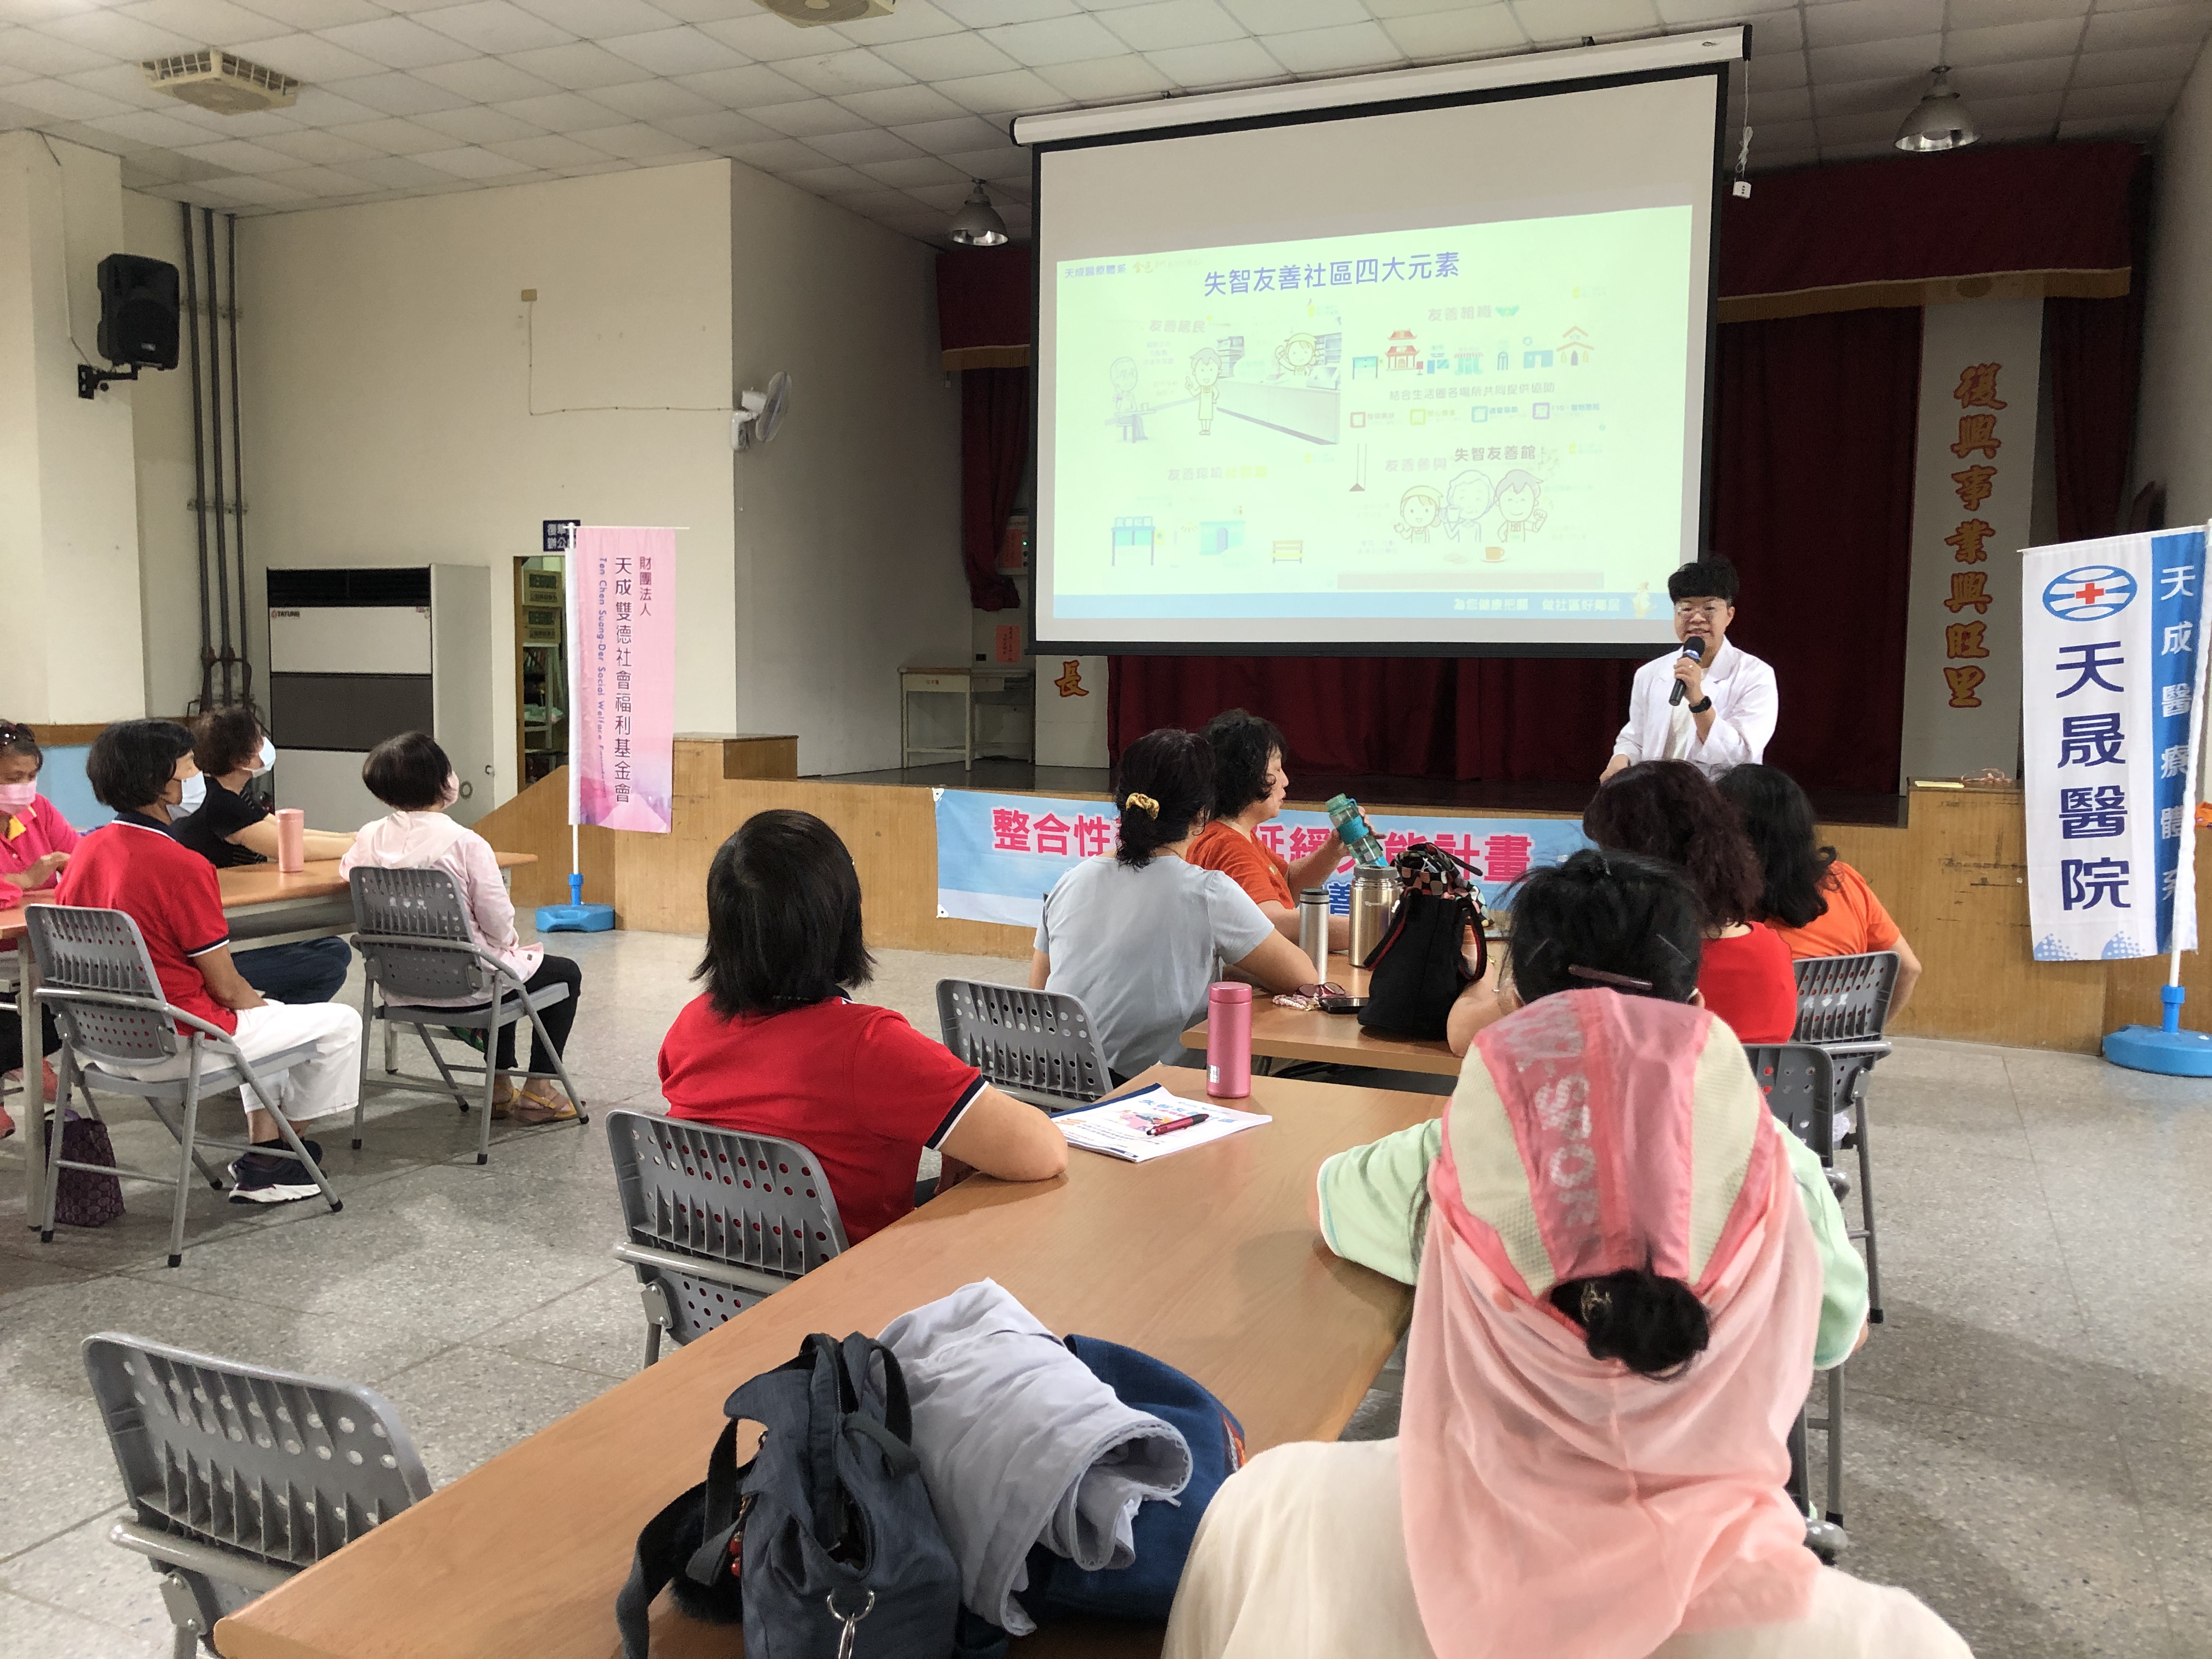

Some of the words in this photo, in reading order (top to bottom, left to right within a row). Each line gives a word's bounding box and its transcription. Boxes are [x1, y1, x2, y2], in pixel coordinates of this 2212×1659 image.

[1204, 251, 1460, 297] 失智友善社區四大元素
[1149, 319, 1206, 334] 友善居民
[1427, 304, 1492, 323] 友善組織
[1454, 445, 1537, 462] 失智友善館
[599, 557, 607, 575] Ten
[598, 579, 607, 605] Chen
[639, 556, 652, 616] 財團法人
[597, 610, 607, 661] Suang-Der
[597, 666, 606, 696] Social
[614, 556, 633, 803] 天成雙德社會福利基金會
[1054, 659, 1090, 698] 長
[2056, 641, 2131, 911] 天晟醫院
